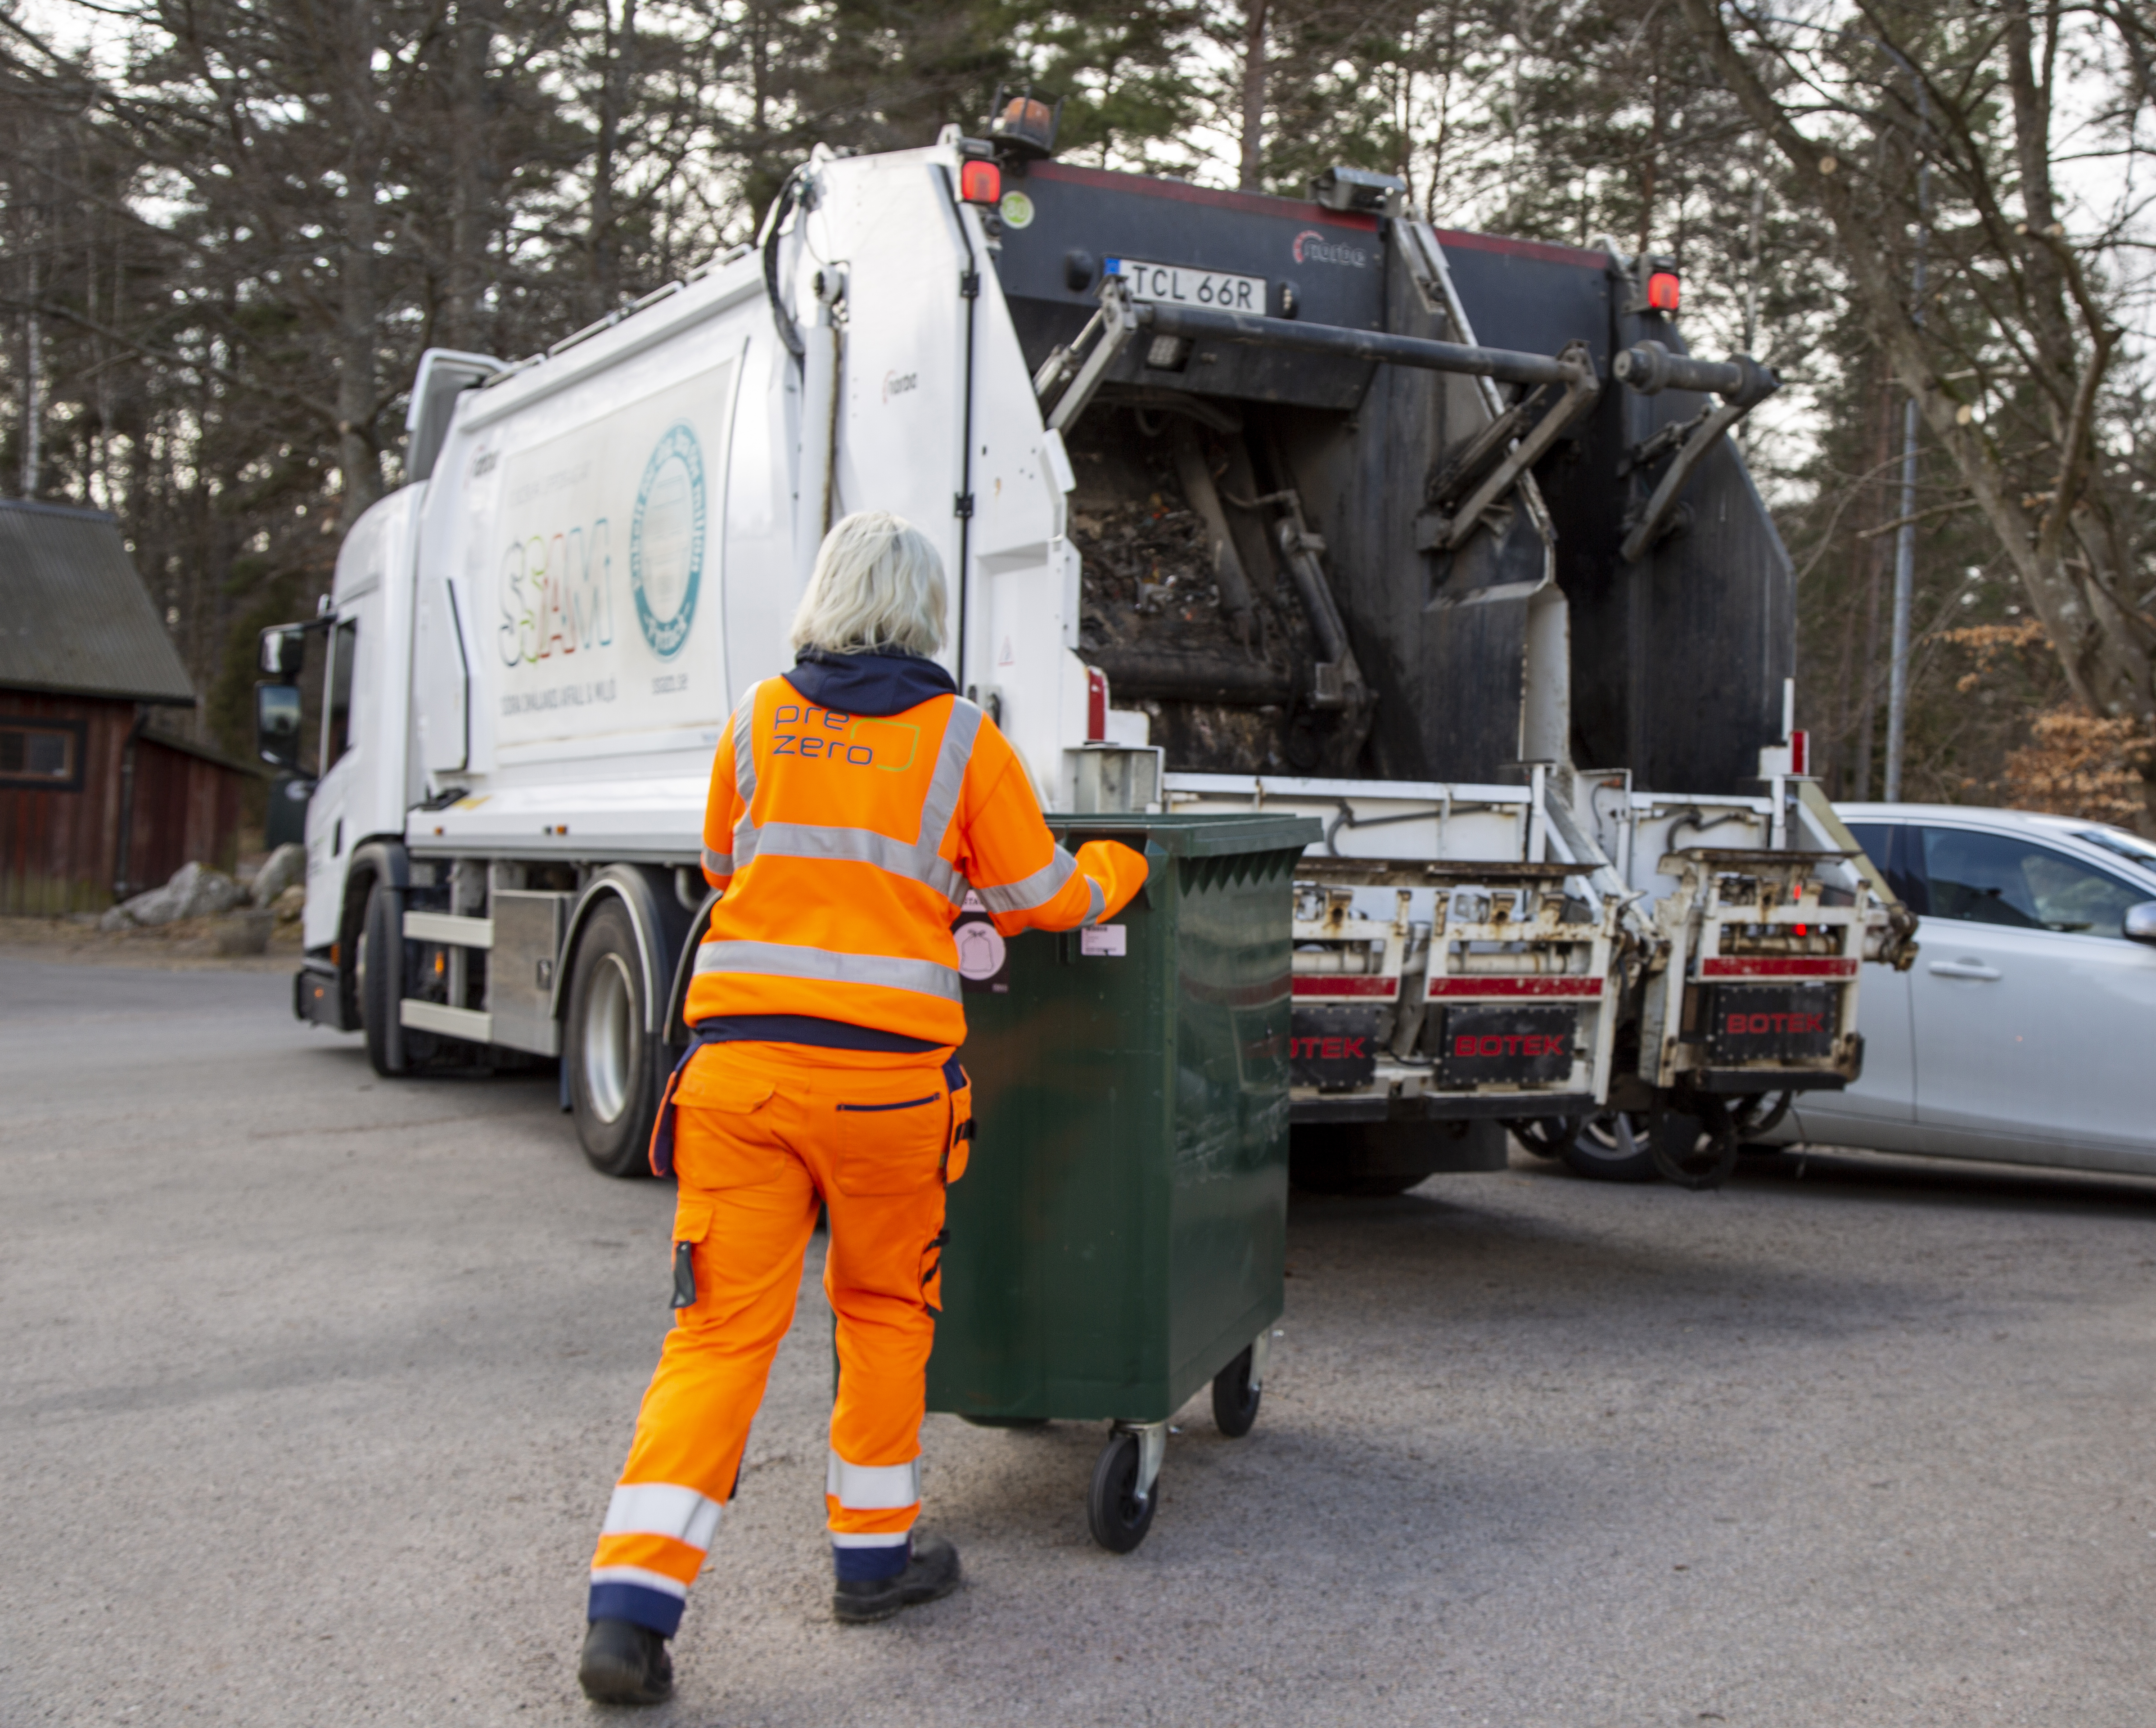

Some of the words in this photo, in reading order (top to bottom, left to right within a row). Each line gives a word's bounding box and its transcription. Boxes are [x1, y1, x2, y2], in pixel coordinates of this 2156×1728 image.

[1132, 265, 1186, 300] TCL
[1197, 274, 1252, 310] 66R
[774, 705, 850, 731] pre
[772, 735, 873, 765] zero
[1726, 1012, 1825, 1034] BOTEK
[1454, 1034, 1565, 1057] BOTEK
